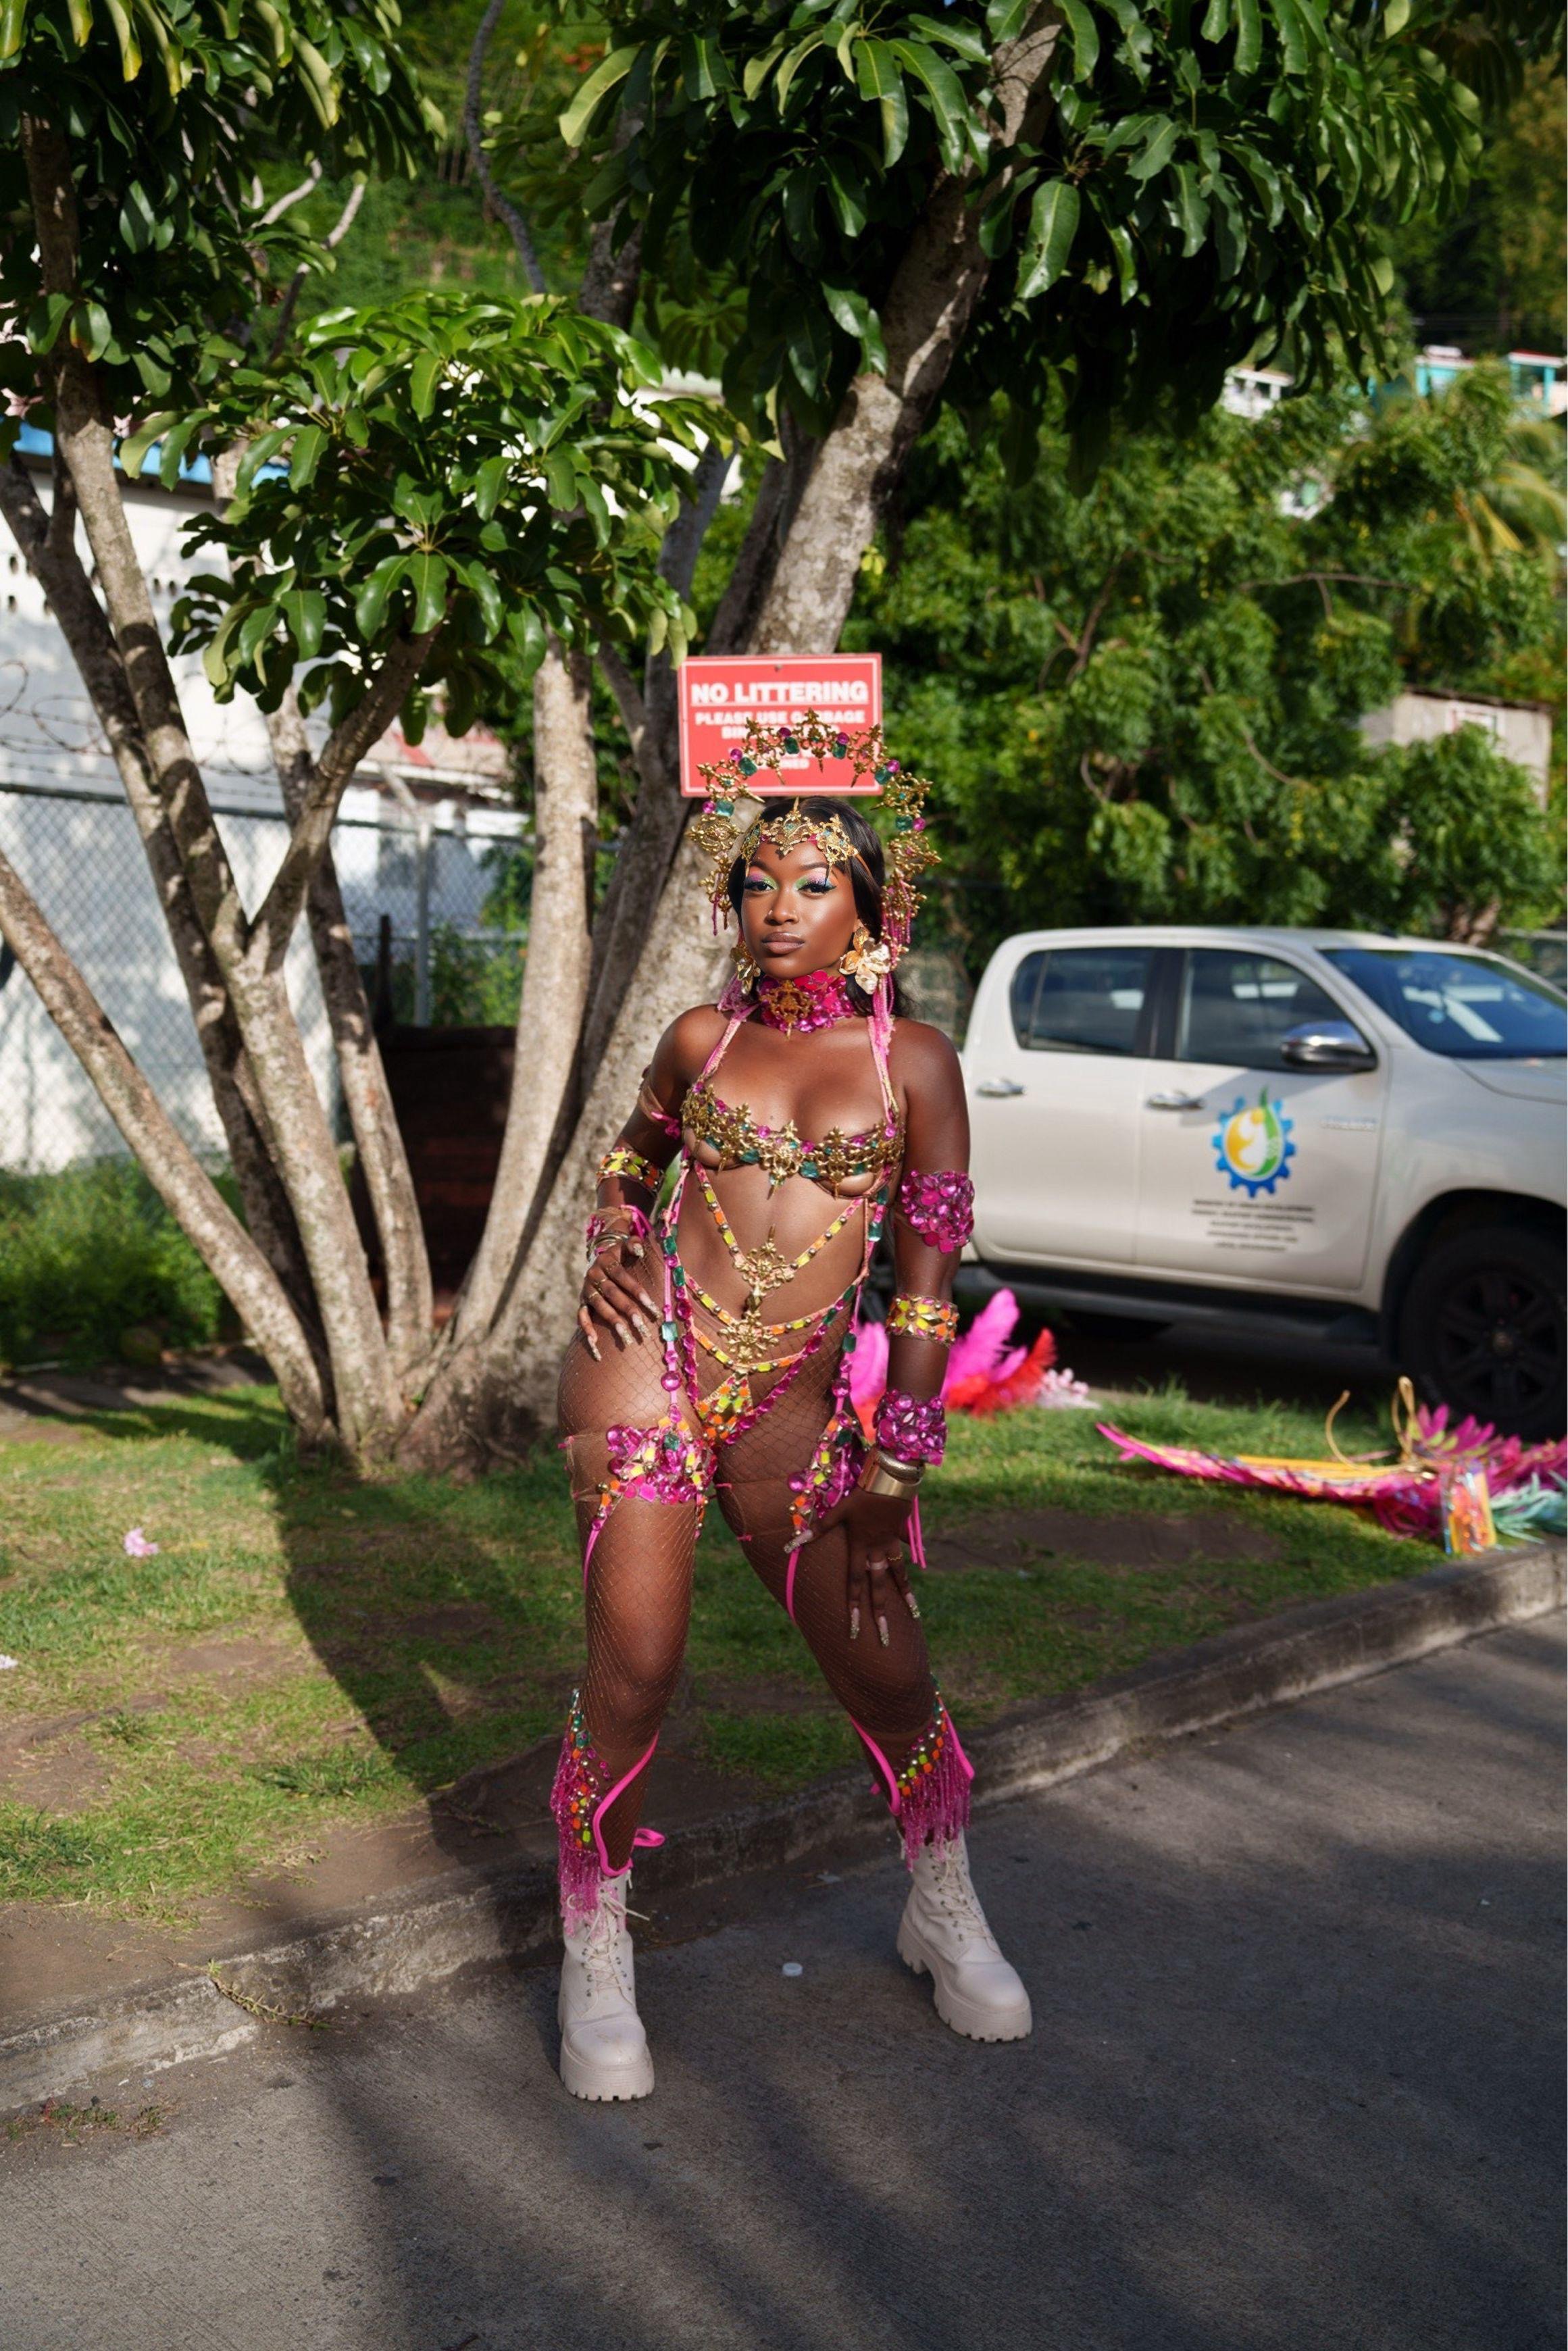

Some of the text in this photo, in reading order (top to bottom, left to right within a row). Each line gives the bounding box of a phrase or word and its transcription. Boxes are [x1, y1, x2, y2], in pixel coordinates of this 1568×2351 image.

[691, 681, 869, 703] NO LITTERING
[695, 712, 753, 725] PLEASE
[756, 711, 788, 724] USE
[722, 726, 755, 739] BIN
